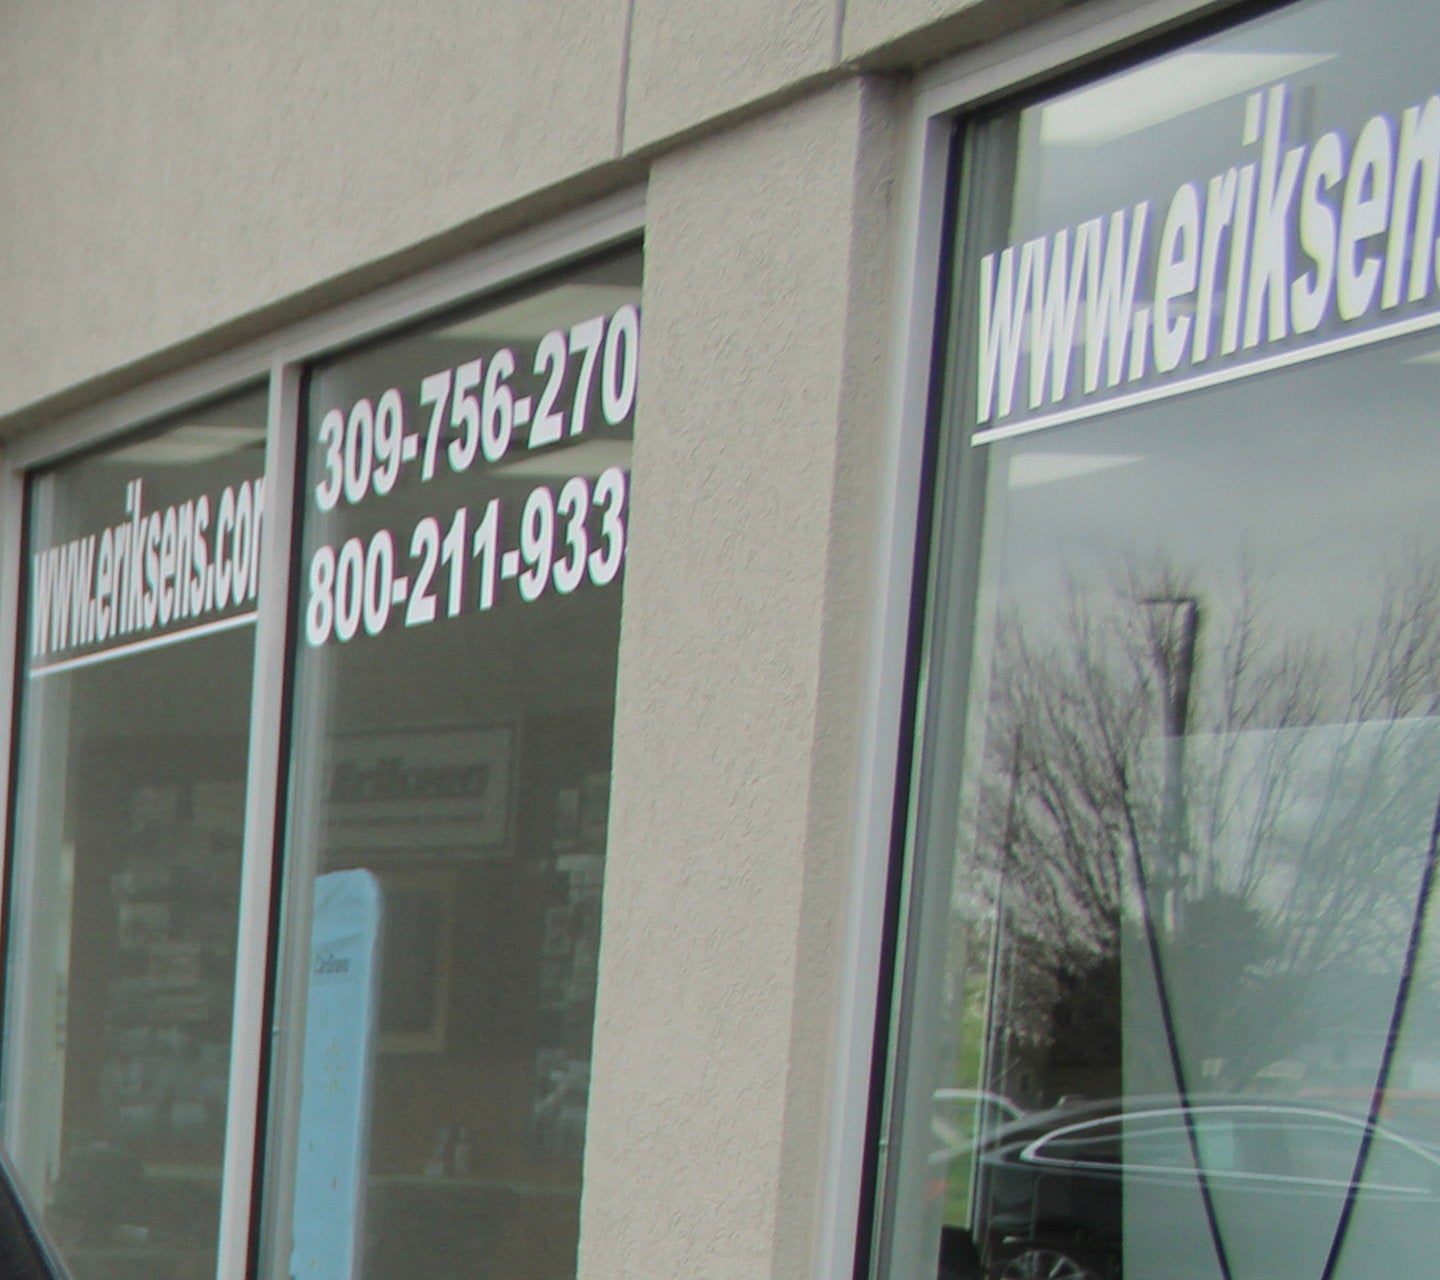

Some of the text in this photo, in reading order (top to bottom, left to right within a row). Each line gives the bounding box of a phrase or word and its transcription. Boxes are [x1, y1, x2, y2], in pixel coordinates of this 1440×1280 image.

[977, 84, 1440, 425] www.eriksen
[314, 304, 639, 512] 309-756-270
[306, 466, 627, 647] 800-211-933
